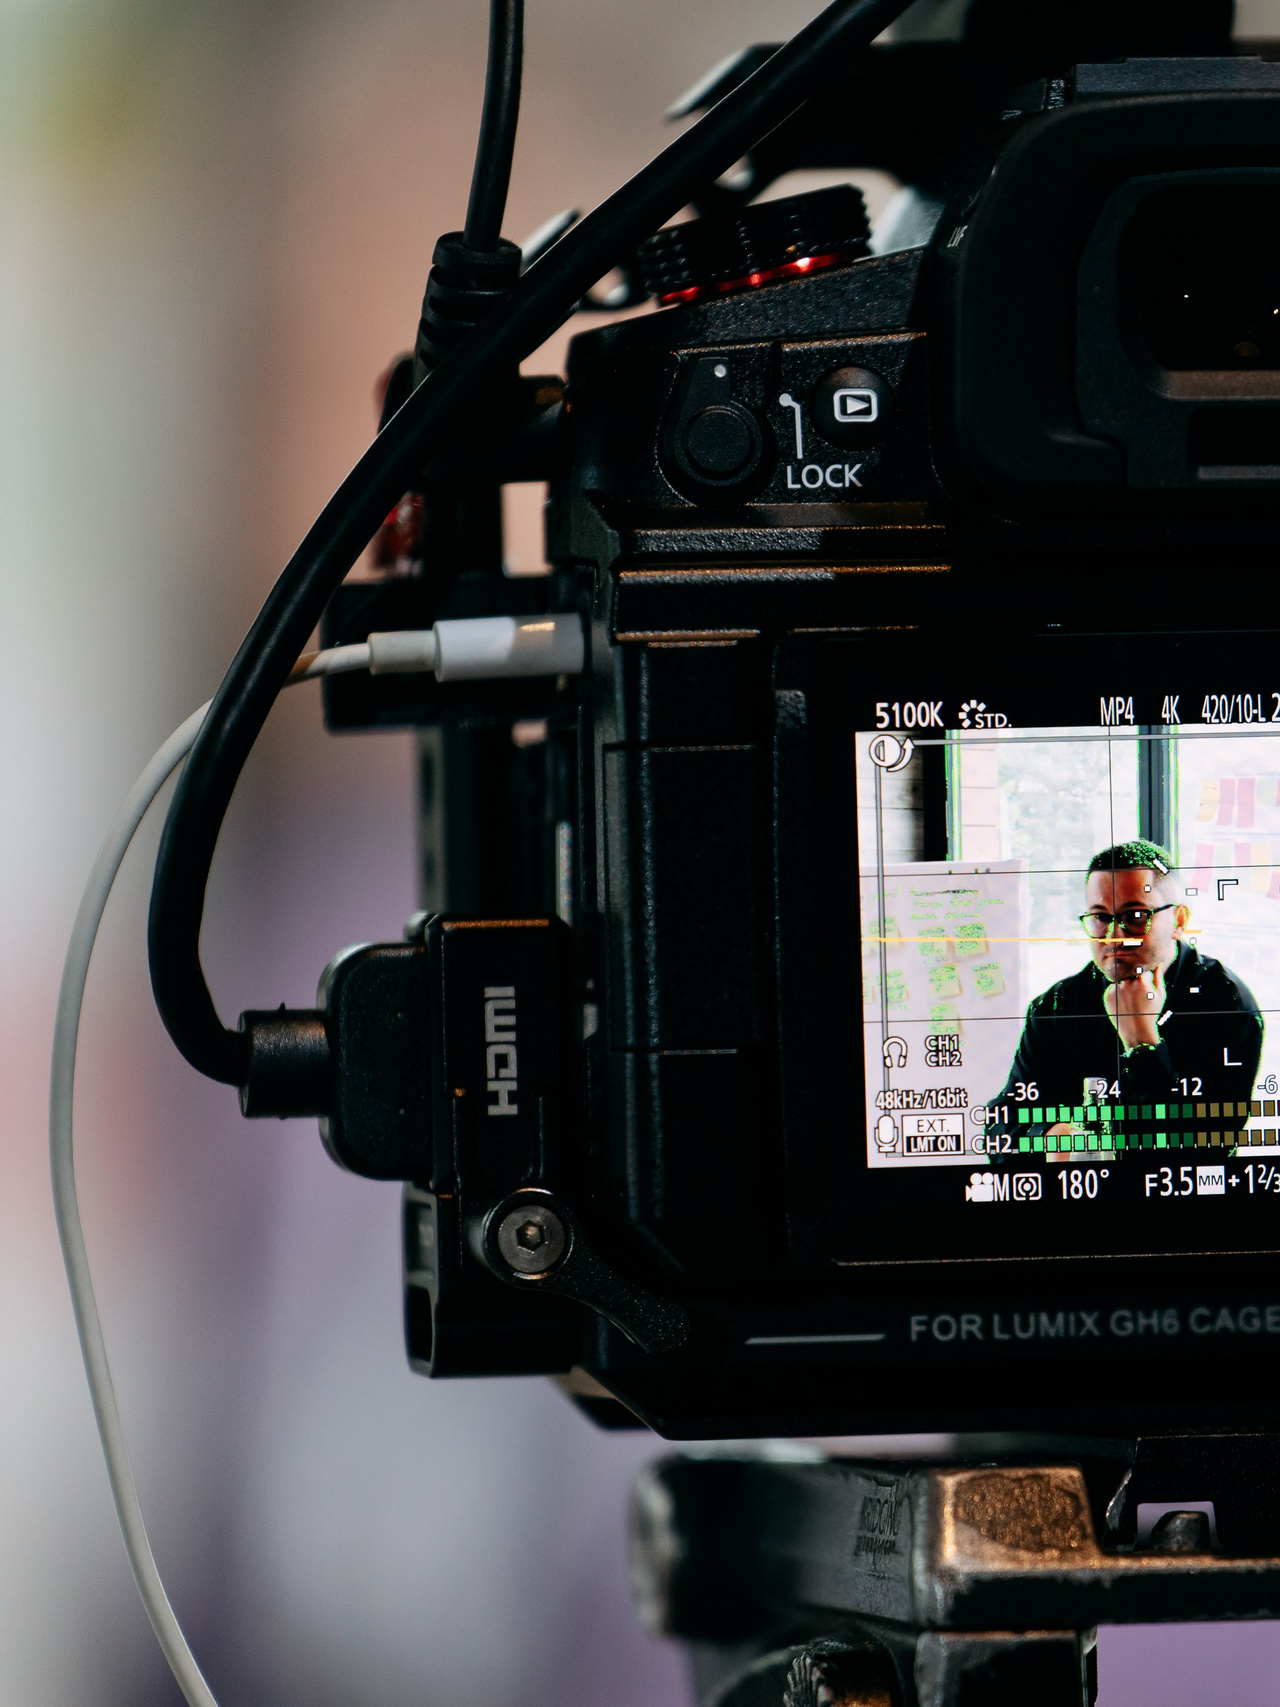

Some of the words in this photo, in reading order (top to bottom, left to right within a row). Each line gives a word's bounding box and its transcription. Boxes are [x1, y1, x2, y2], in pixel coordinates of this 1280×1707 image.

[786, 463, 862, 489] LOCK
[876, 701, 944, 729] 5100K
[1100, 695, 1135, 726] MP4
[1161, 695, 1181, 725] 4K
[1201, 693, 1266, 724] 420/10-L
[975, 713, 1012, 729] STD.
[484, 986, 518, 1116] HDMI
[925, 1035, 959, 1051] CH1
[925, 1051, 962, 1067] CH2
[875, 1088, 968, 1110] 48kHz/16bit
[1006, 1082, 1039, 1102] -36
[1089, 1079, 1121, 1099] -24
[1171, 1077, 1202, 1097] -12
[1257, 1074, 1278, 1094] -6
[917, 1118, 950, 1134] EXT.
[970, 1105, 1009, 1125] CH1
[910, 1137, 932, 1152] LMT
[935, 1135, 957, 1151] ON
[971, 1134, 1012, 1155] CH2
[994, 1173, 1009, 1202] M
[1058, 1168, 1110, 1199] 180°
[1145, 1166, 1194, 1197] F3.5
[1198, 1174, 1224, 1187] MM
[910, 1314, 983, 1341] FOR
[993, 1311, 1101, 1340] LUMIX
[1110, 1309, 1180, 1337] GH6
